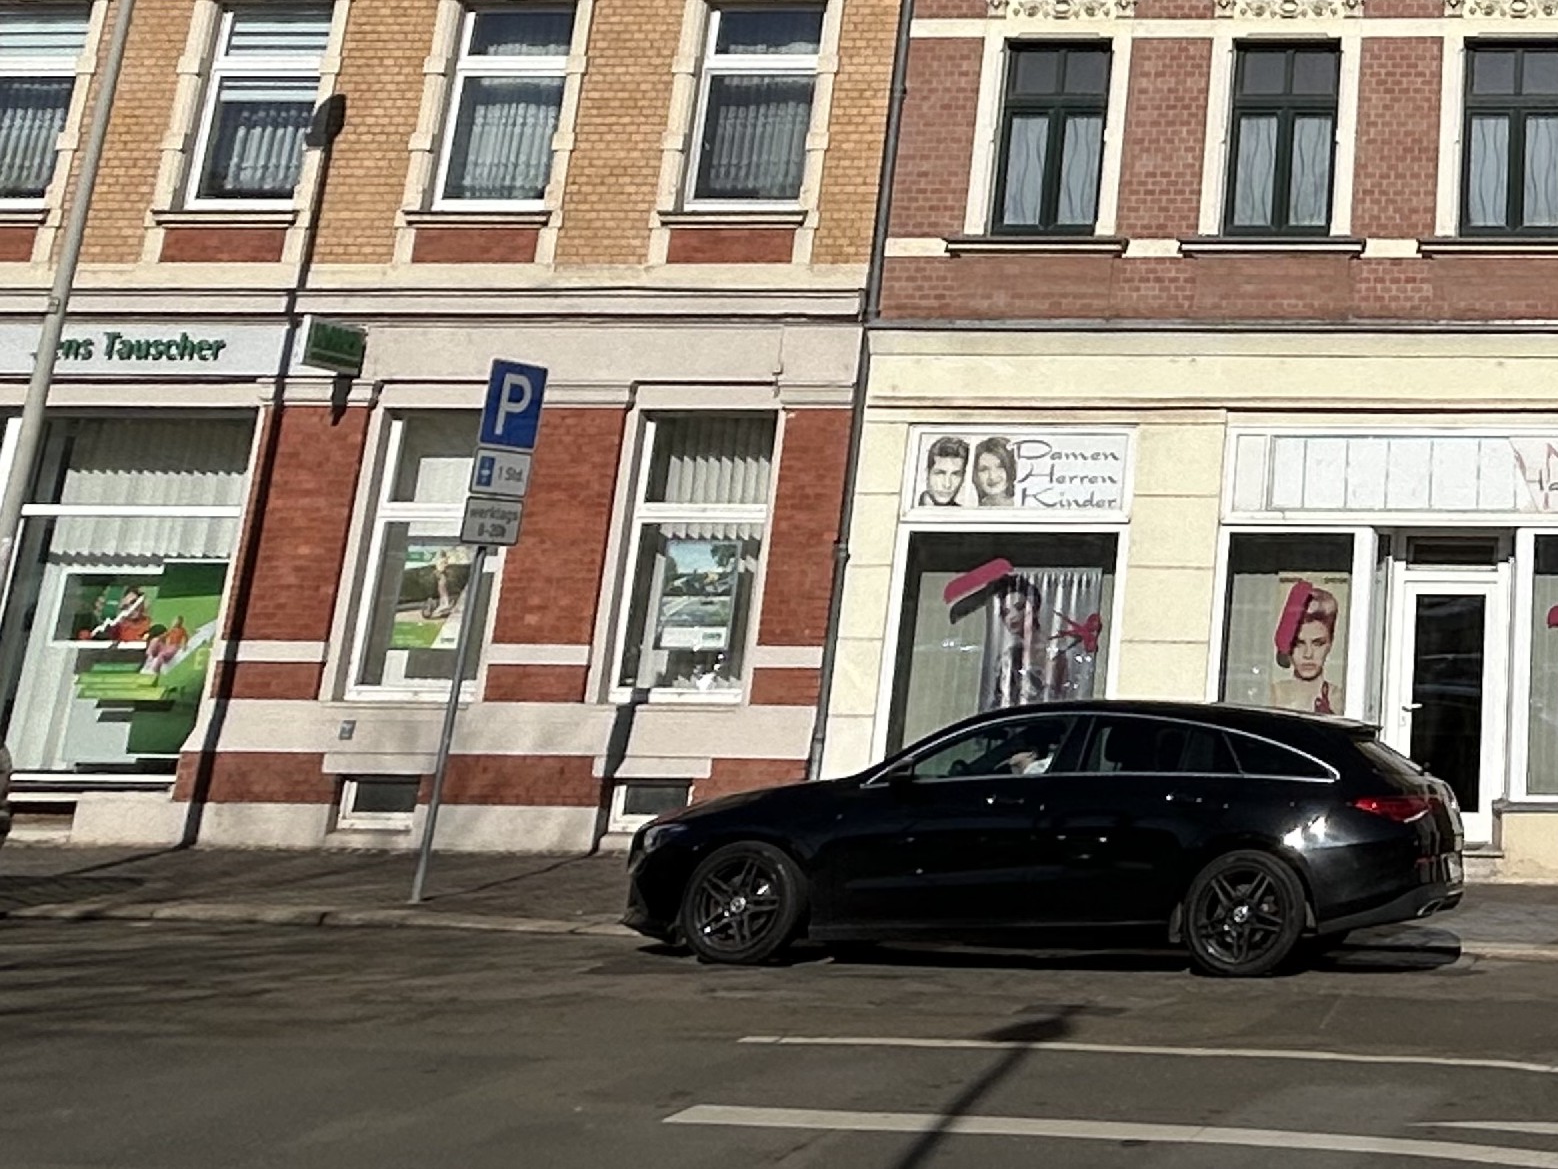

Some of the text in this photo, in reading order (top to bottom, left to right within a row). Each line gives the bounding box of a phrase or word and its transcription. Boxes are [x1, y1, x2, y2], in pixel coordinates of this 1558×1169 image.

[32, 331, 227, 361] ens Tauscher
[494, 373, 532, 435] P
[1009, 439, 1120, 461] Damen
[1016, 463, 1118, 484] Herren
[1021, 487, 1118, 509] Kinder
